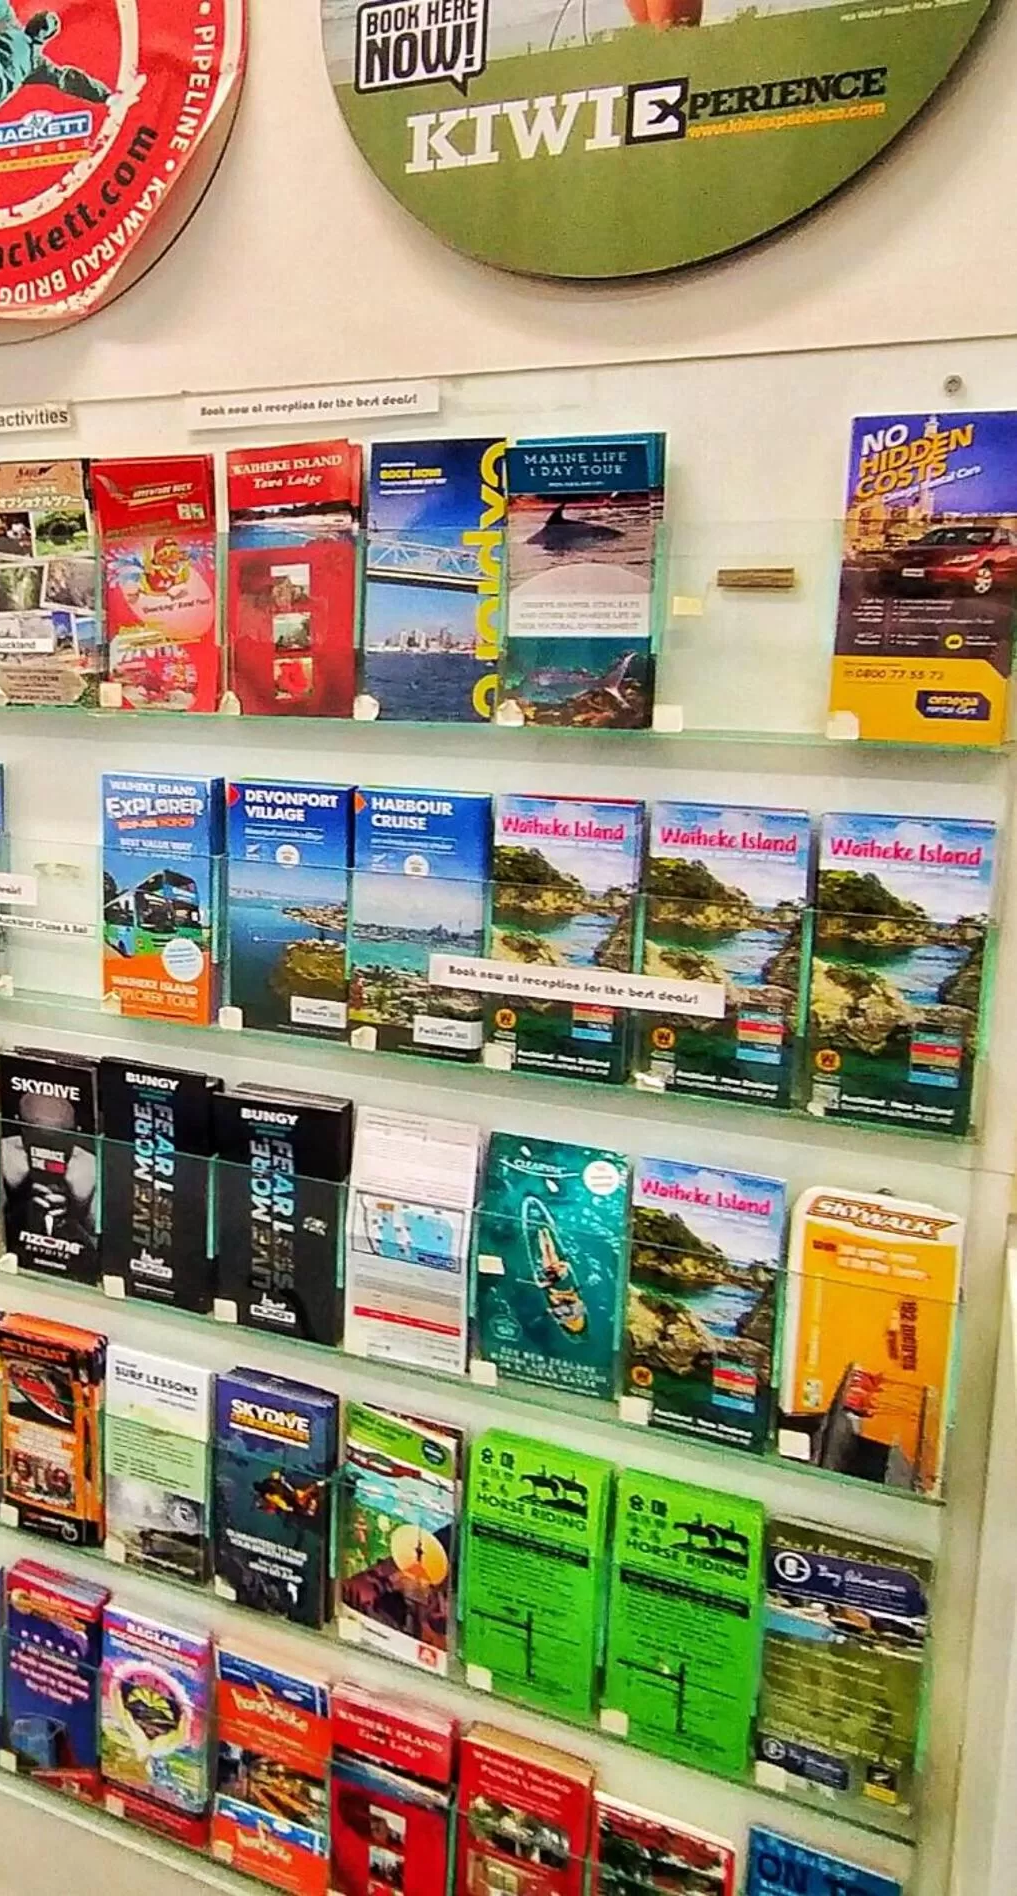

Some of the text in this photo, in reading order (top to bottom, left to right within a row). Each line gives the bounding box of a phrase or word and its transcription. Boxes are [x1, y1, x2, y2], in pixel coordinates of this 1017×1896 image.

[365, 0, 478, 39] BOOK HERE
[363, 25, 479, 80] NOW!
[175, 23, 216, 156] PIPELINE
[405, 85, 625, 173] KIWI
[72, 178, 166, 286] KAWARAU
[201, 405, 225, 418] Book
[228, 405, 249, 415] now
[266, 401, 315, 414] reception
[318, 399, 334, 410] for
[337, 397, 353, 409] the
[357, 396, 380, 408] best
[858, 423, 976, 478] HIDDEN
[860, 423, 909, 456] NO
[231, 453, 343, 478] WAIHEKE ISLAND
[524, 451, 629, 465] MARINE LIFE
[541, 466, 573, 477] DAY
[582, 463, 623, 475] TOUR
[286, 471, 323, 488] Lodge
[854, 453, 948, 499] COSTS
[157, 783, 197, 797] ISLAND
[244, 788, 339, 809] DEVONPORT
[105, 796, 204, 819] EXPLORER
[245, 805, 306, 823] VILLAGE
[371, 796, 454, 817] HARBOUR
[371, 813, 427, 832] CRUISE
[501, 815, 626, 841] Waiheke Island
[661, 825, 798, 853] Waiheke Island
[830, 836, 983, 866] Waiheke Island
[448, 964, 476, 979] Book
[480, 969, 503, 981] now
[522, 975, 581, 992] reception
[584, 981, 602, 994] for
[604, 983, 626, 997] the
[627, 986, 656, 1001] best
[10, 1076, 80, 1102] SKYDIVE
[125, 1071, 180, 1092] BUNGY
[240, 1107, 300, 1127] BUNGY
[639, 1177, 772, 1217] Waiheke Island
[815, 1199, 937, 1236] SKYWALK
[114, 1365, 198, 1397] SURF LESSONS
[230, 1398, 310, 1434] SKYDIVE
[476, 1492, 588, 1532] HORSE RIDING
[626, 1539, 680, 1563] HORSE
[685, 1548, 749, 1581] RIDING
